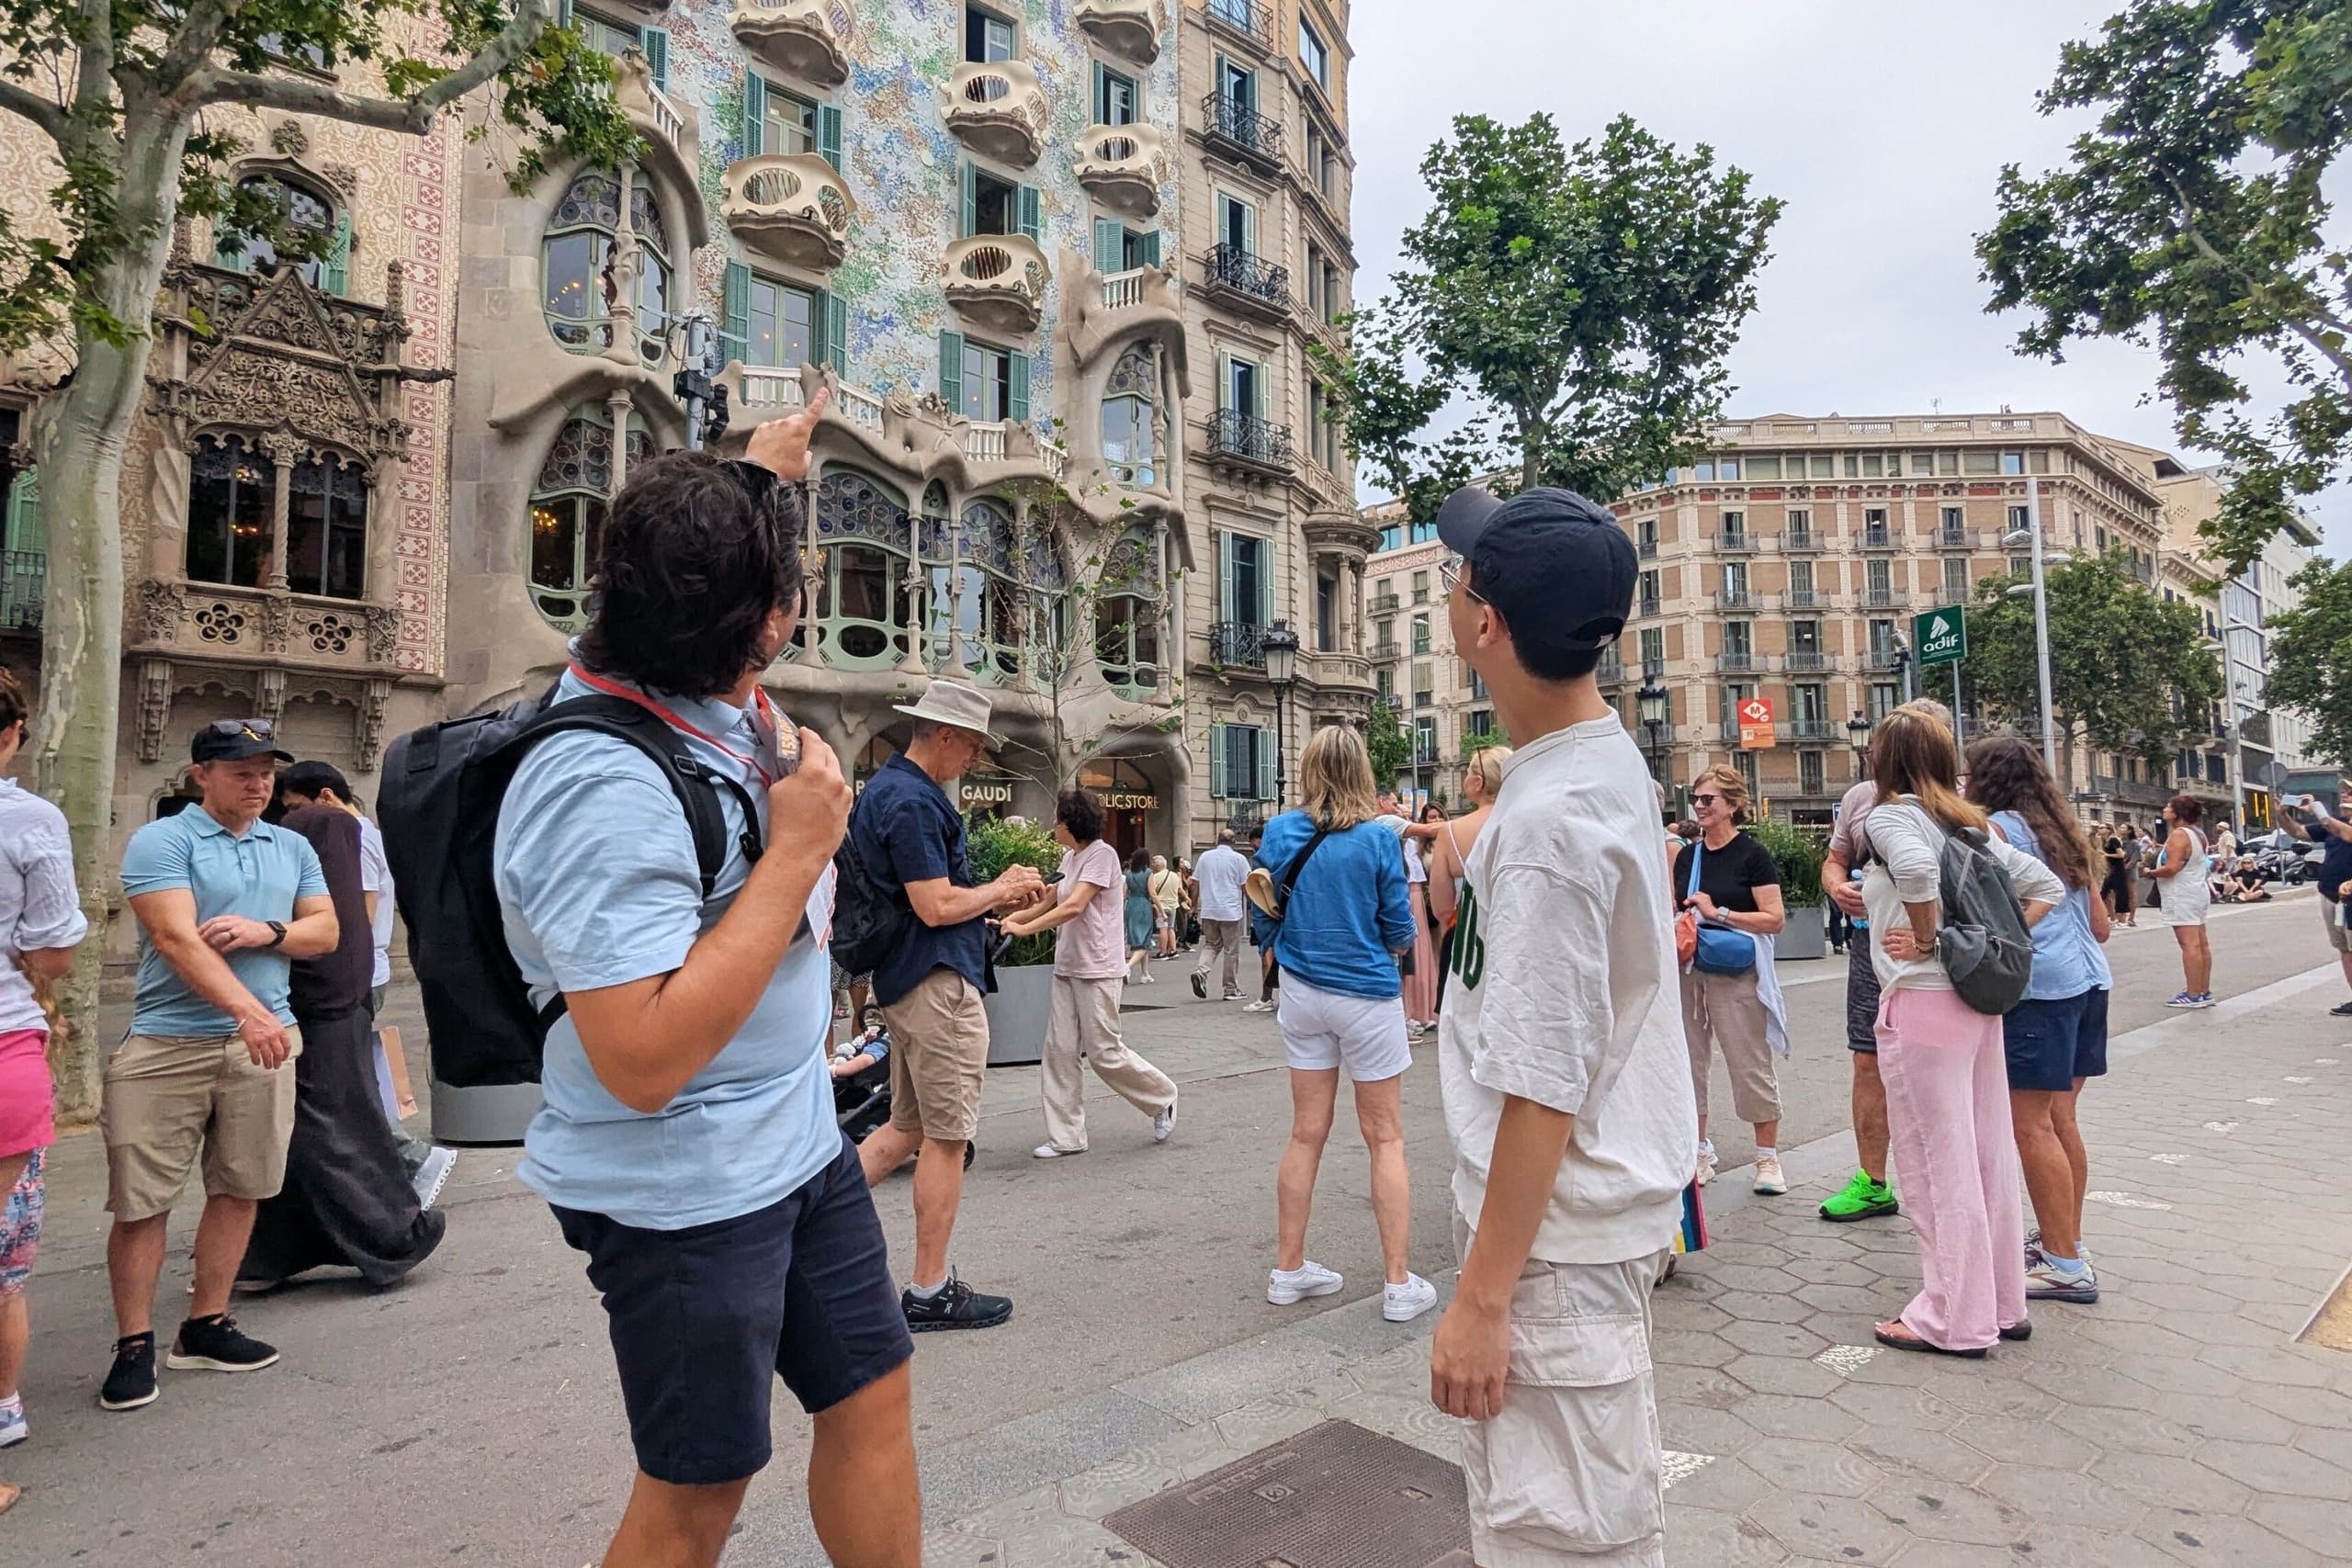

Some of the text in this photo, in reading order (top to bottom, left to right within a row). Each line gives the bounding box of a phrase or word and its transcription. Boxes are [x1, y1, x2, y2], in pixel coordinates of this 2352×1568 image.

[1923, 634, 1959, 652] adif
[1750, 706, 1760, 715] M
[961, 783, 1012, 802] GAUDÍ
[1125, 794, 1160, 809] STORE
